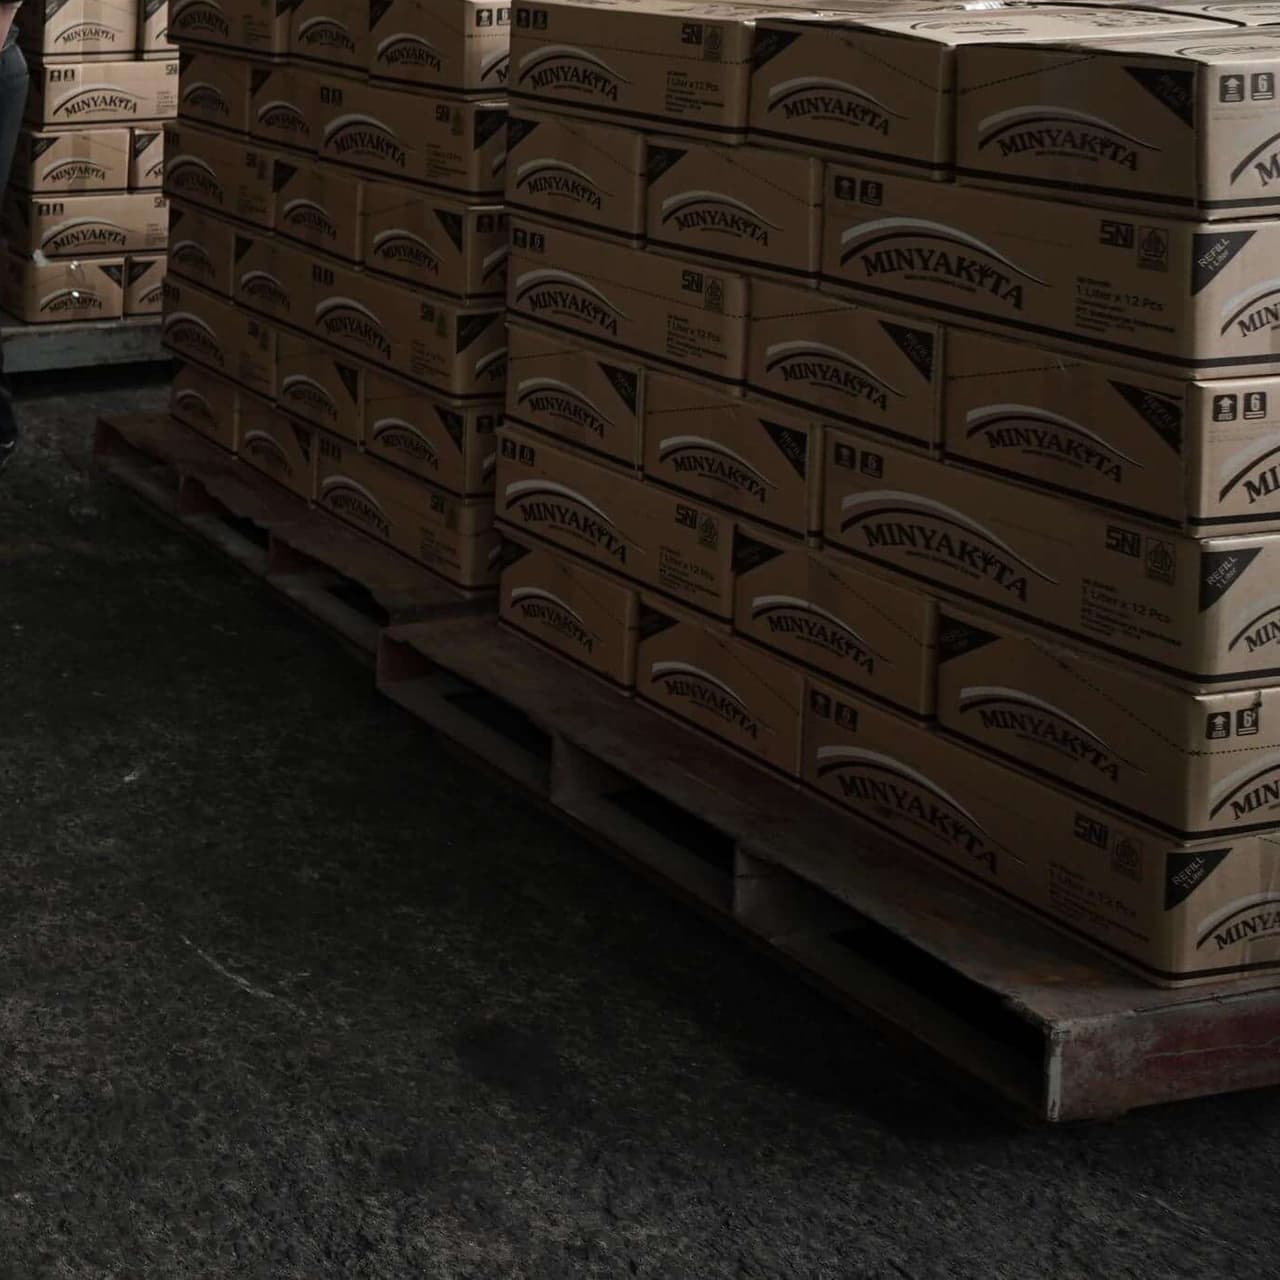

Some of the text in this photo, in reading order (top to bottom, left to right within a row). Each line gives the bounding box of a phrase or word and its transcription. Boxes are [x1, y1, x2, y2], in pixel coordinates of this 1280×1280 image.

[62, 27, 115, 43] MINYAKITA
[682, 23, 702, 44] SNI
[386, 47, 441, 72] MINYAKITA
[531, 65, 618, 101] MINYAKITA
[64, 95, 138, 117] MINYAKITA
[782, 95, 890, 136] MINYAKITA
[334, 137, 406, 168] MINYAKITA
[996, 128, 1138, 171] MINYAKITA
[50, 165, 106, 183] MINYAKITA
[527, 176, 602, 211] MINYAKITA
[53, 229, 127, 251] MINYAKITA
[675, 210, 768, 247] MINYAKITA
[1100, 220, 1134, 249] SNI
[1198, 237, 1230, 268] REFILL
[682, 270, 702, 293] SNI
[860, 247, 1024, 310] MINYAKITA
[1084, 285, 1116, 303] Liter
[1126, 296, 1139, 307] 12
[529, 291, 618, 337] MINYAKITA
[780, 362, 887, 411] MINYAKITA
[529, 396, 605, 438] MINYAKITA
[984, 427, 1123, 483] MINYAKITA
[672, 455, 766, 504] MINYAKITA
[519, 502, 628, 564] MINYAKITA
[675, 503, 698, 529] SNI
[1105, 525, 1140, 559] SNI
[862, 523, 1028, 602] MINYAKITA
[1207, 555, 1238, 587] REFILL
[767, 615, 875, 676] MINYAKITA
[665, 679, 758, 740] MINYAKITA
[979, 709, 1120, 782] MINYAKITA
[838, 774, 997, 875] MINYAKITA
[1074, 811, 1109, 850] SNI
[1170, 855, 1205, 887] REFILL
